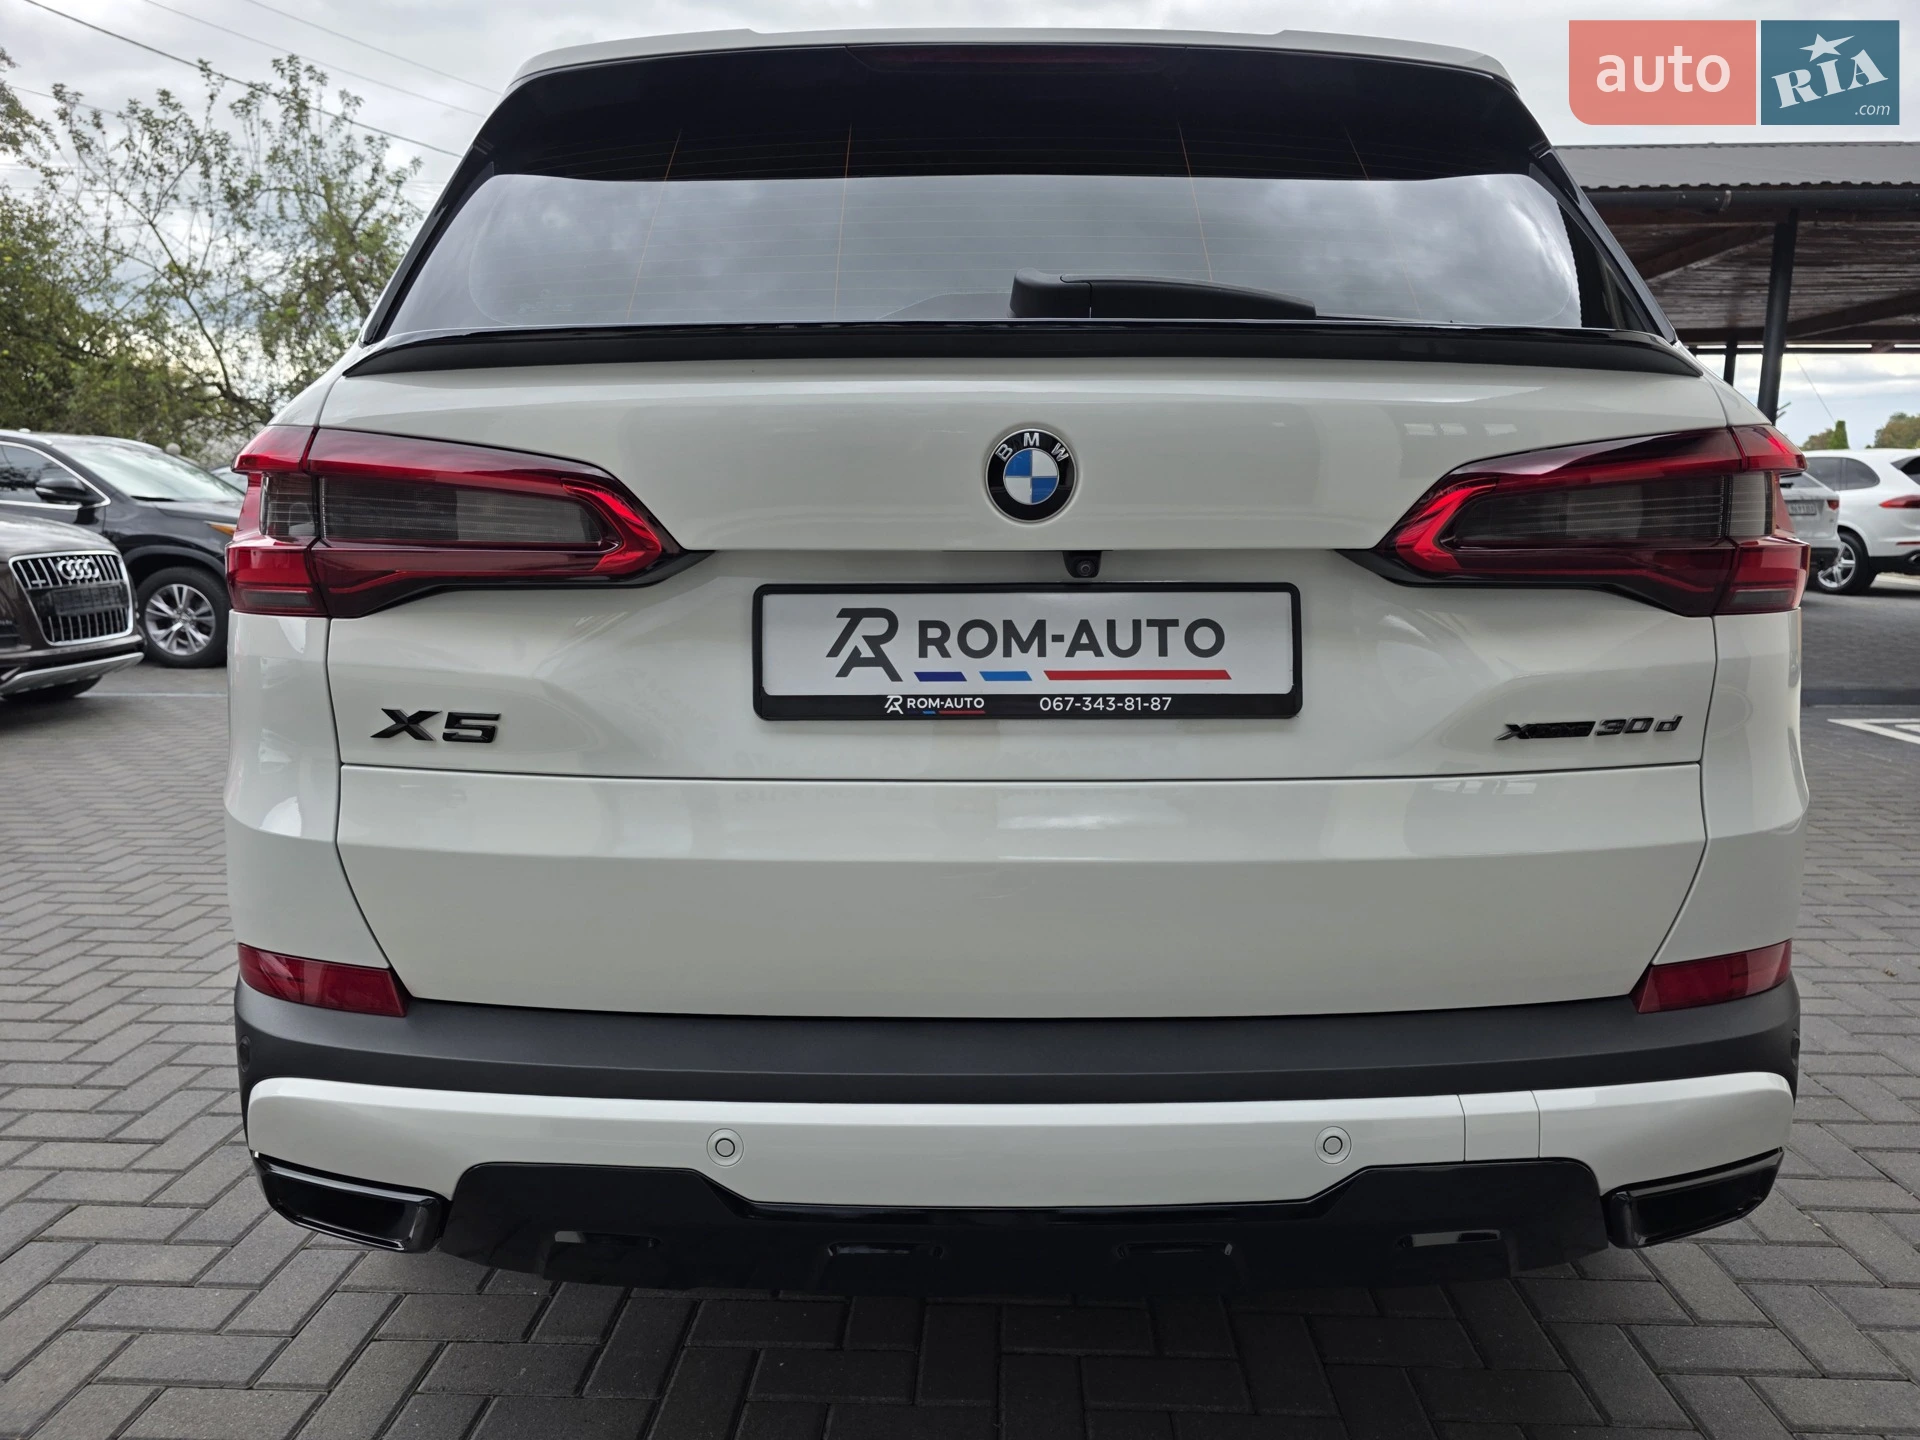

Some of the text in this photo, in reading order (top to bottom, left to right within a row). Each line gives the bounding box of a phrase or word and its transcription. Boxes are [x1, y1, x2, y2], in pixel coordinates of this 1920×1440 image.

[995, 432, 1070, 463] BMW
[918, 618, 1226, 659] ROM-AUTO
[906, 697, 986, 710] ROM-AUTO
[1038, 696, 1173, 712] 067-343-81-87
[369, 707, 502, 744] X5
